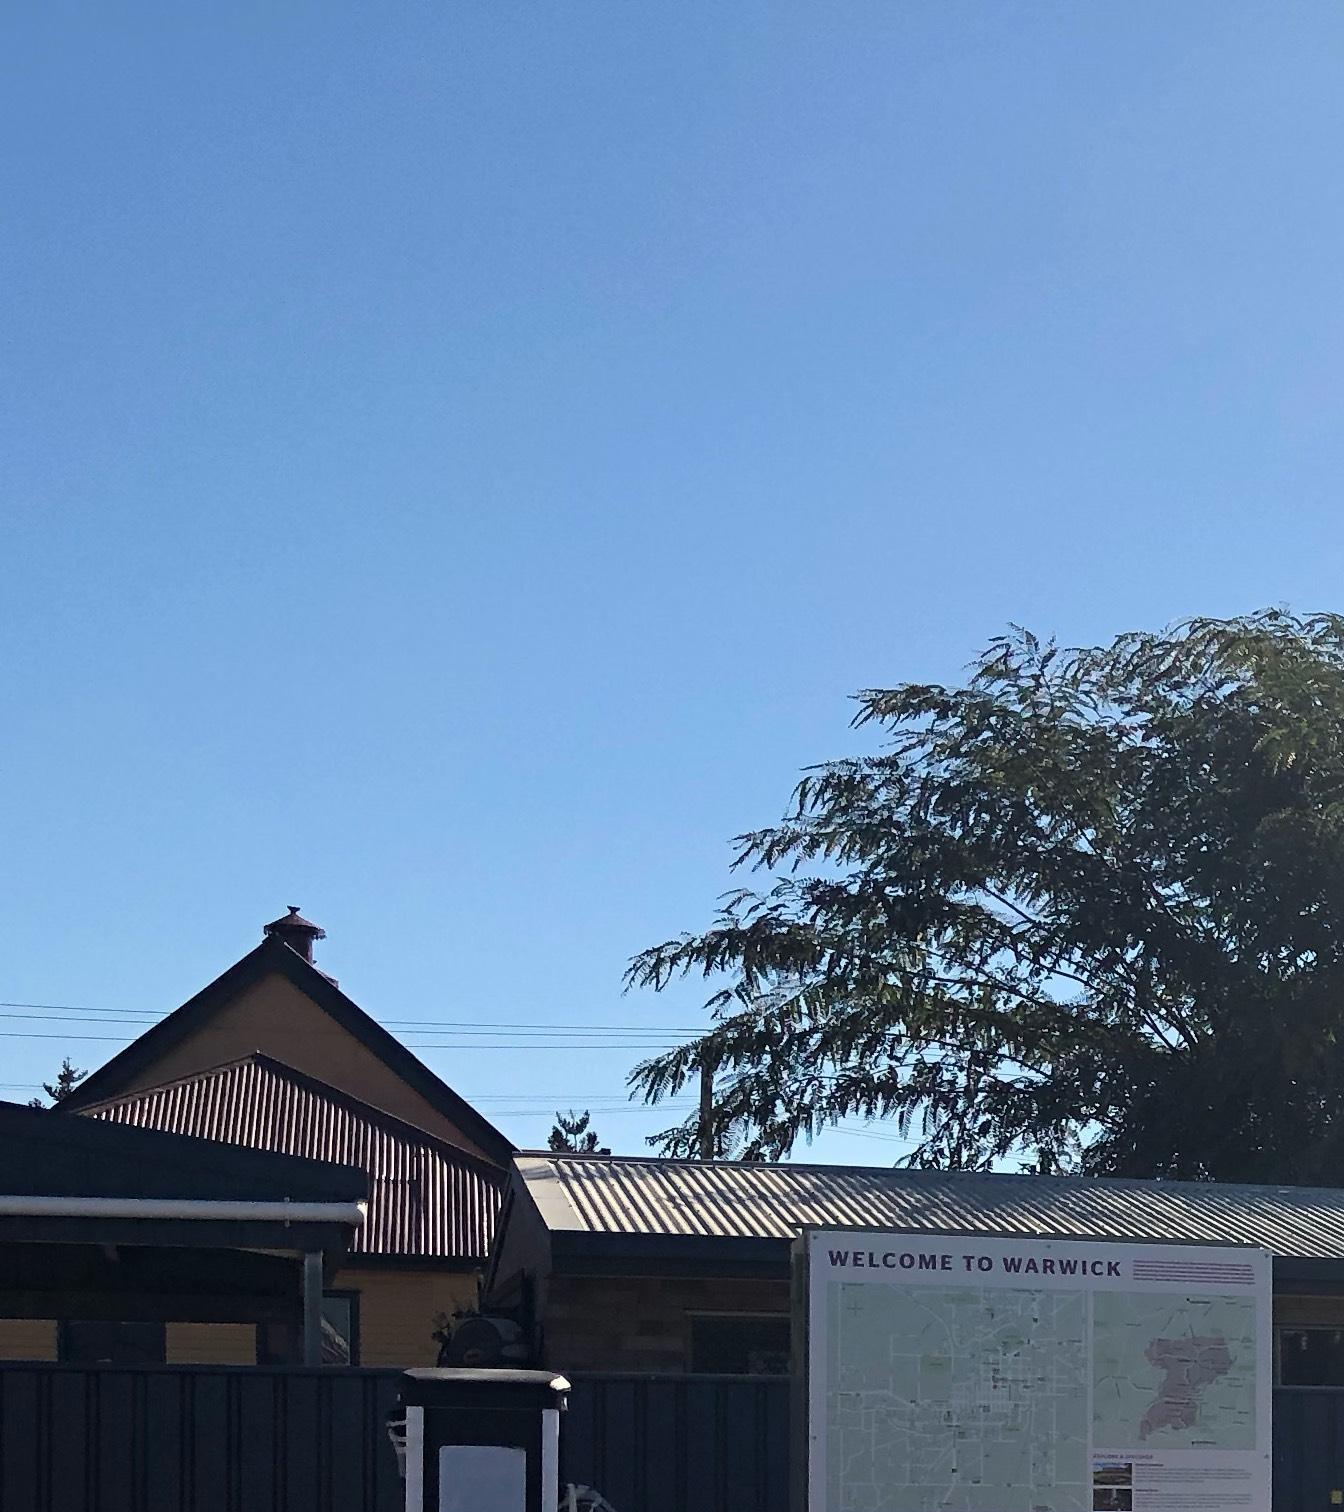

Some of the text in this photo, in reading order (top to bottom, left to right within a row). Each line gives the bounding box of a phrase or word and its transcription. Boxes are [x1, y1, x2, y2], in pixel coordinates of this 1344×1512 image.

[828, 1249, 954, 1273] WELCOME
[961, 1255, 994, 1273] TO
[1002, 1257, 1123, 1278] WARWICK
